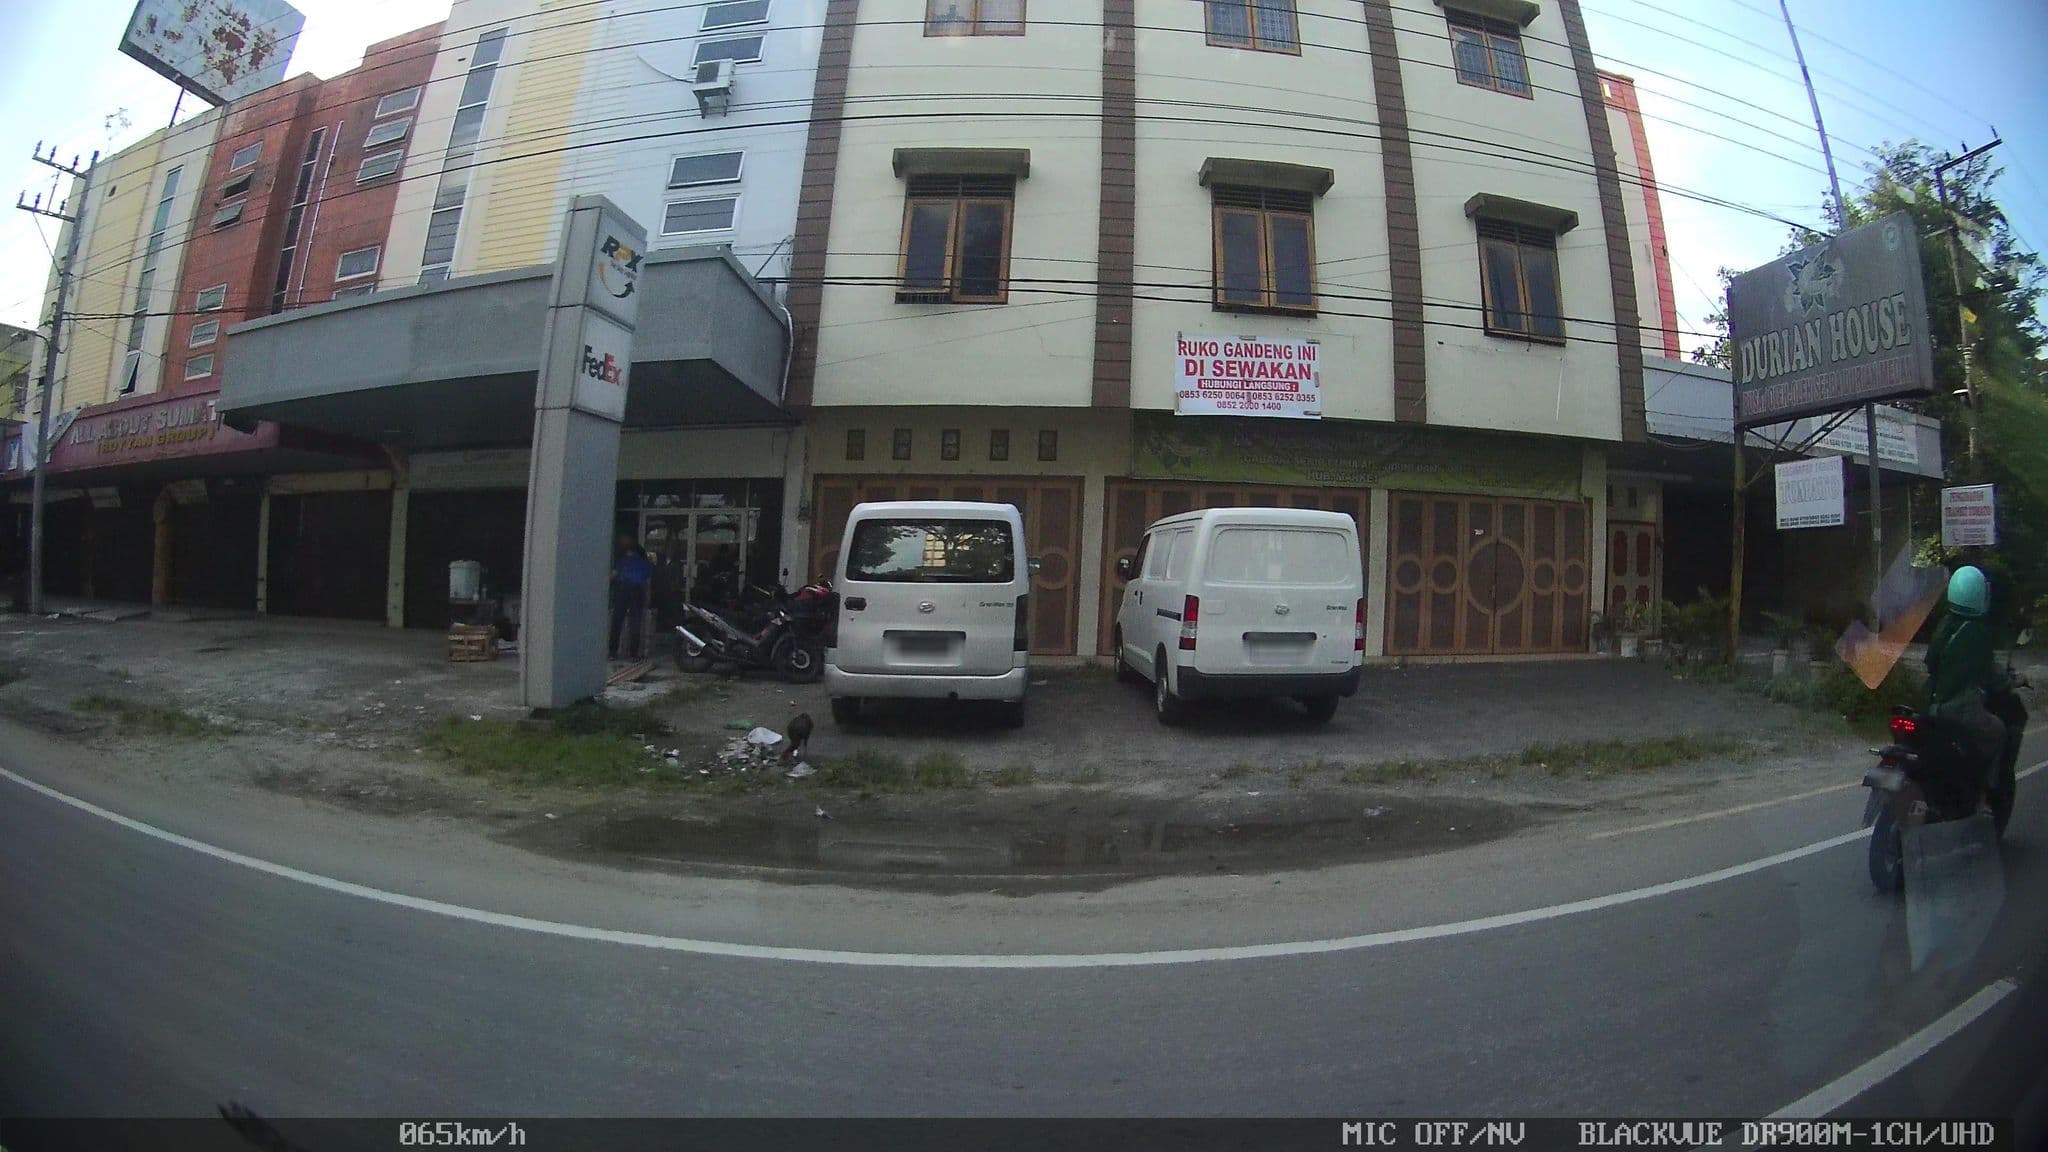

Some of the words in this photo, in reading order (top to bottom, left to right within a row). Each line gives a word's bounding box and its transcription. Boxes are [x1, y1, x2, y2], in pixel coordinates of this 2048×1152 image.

[600, 235, 644, 273] RPX
[1741, 318, 1822, 383] DURIAN
[1829, 291, 1912, 362] HOUSE
[1178, 340, 1219, 356] RUKO
[1224, 342, 1293, 360] GANDENG
[1297, 345, 1316, 361] INI
[582, 345, 621, 386] FedEx
[1185, 359, 1205, 377] DI
[1212, 360, 1311, 380] SEWAKAN
[1201, 380, 1242, 389] HUBUNGI
[1179, 390, 1200, 399] 0853
[1203, 391, 1223, 399] 6250
[1226, 391, 1245, 400] 0064
[1252, 392, 1272, 400] 0853
[1275, 393, 1294, 401] 6252
[1297, 393, 1316, 402] 0355
[1217, 401, 1237, 410] 0852
[1239, 402, 1259, 410] 2000
[1262, 402, 1281, 411] 1400
